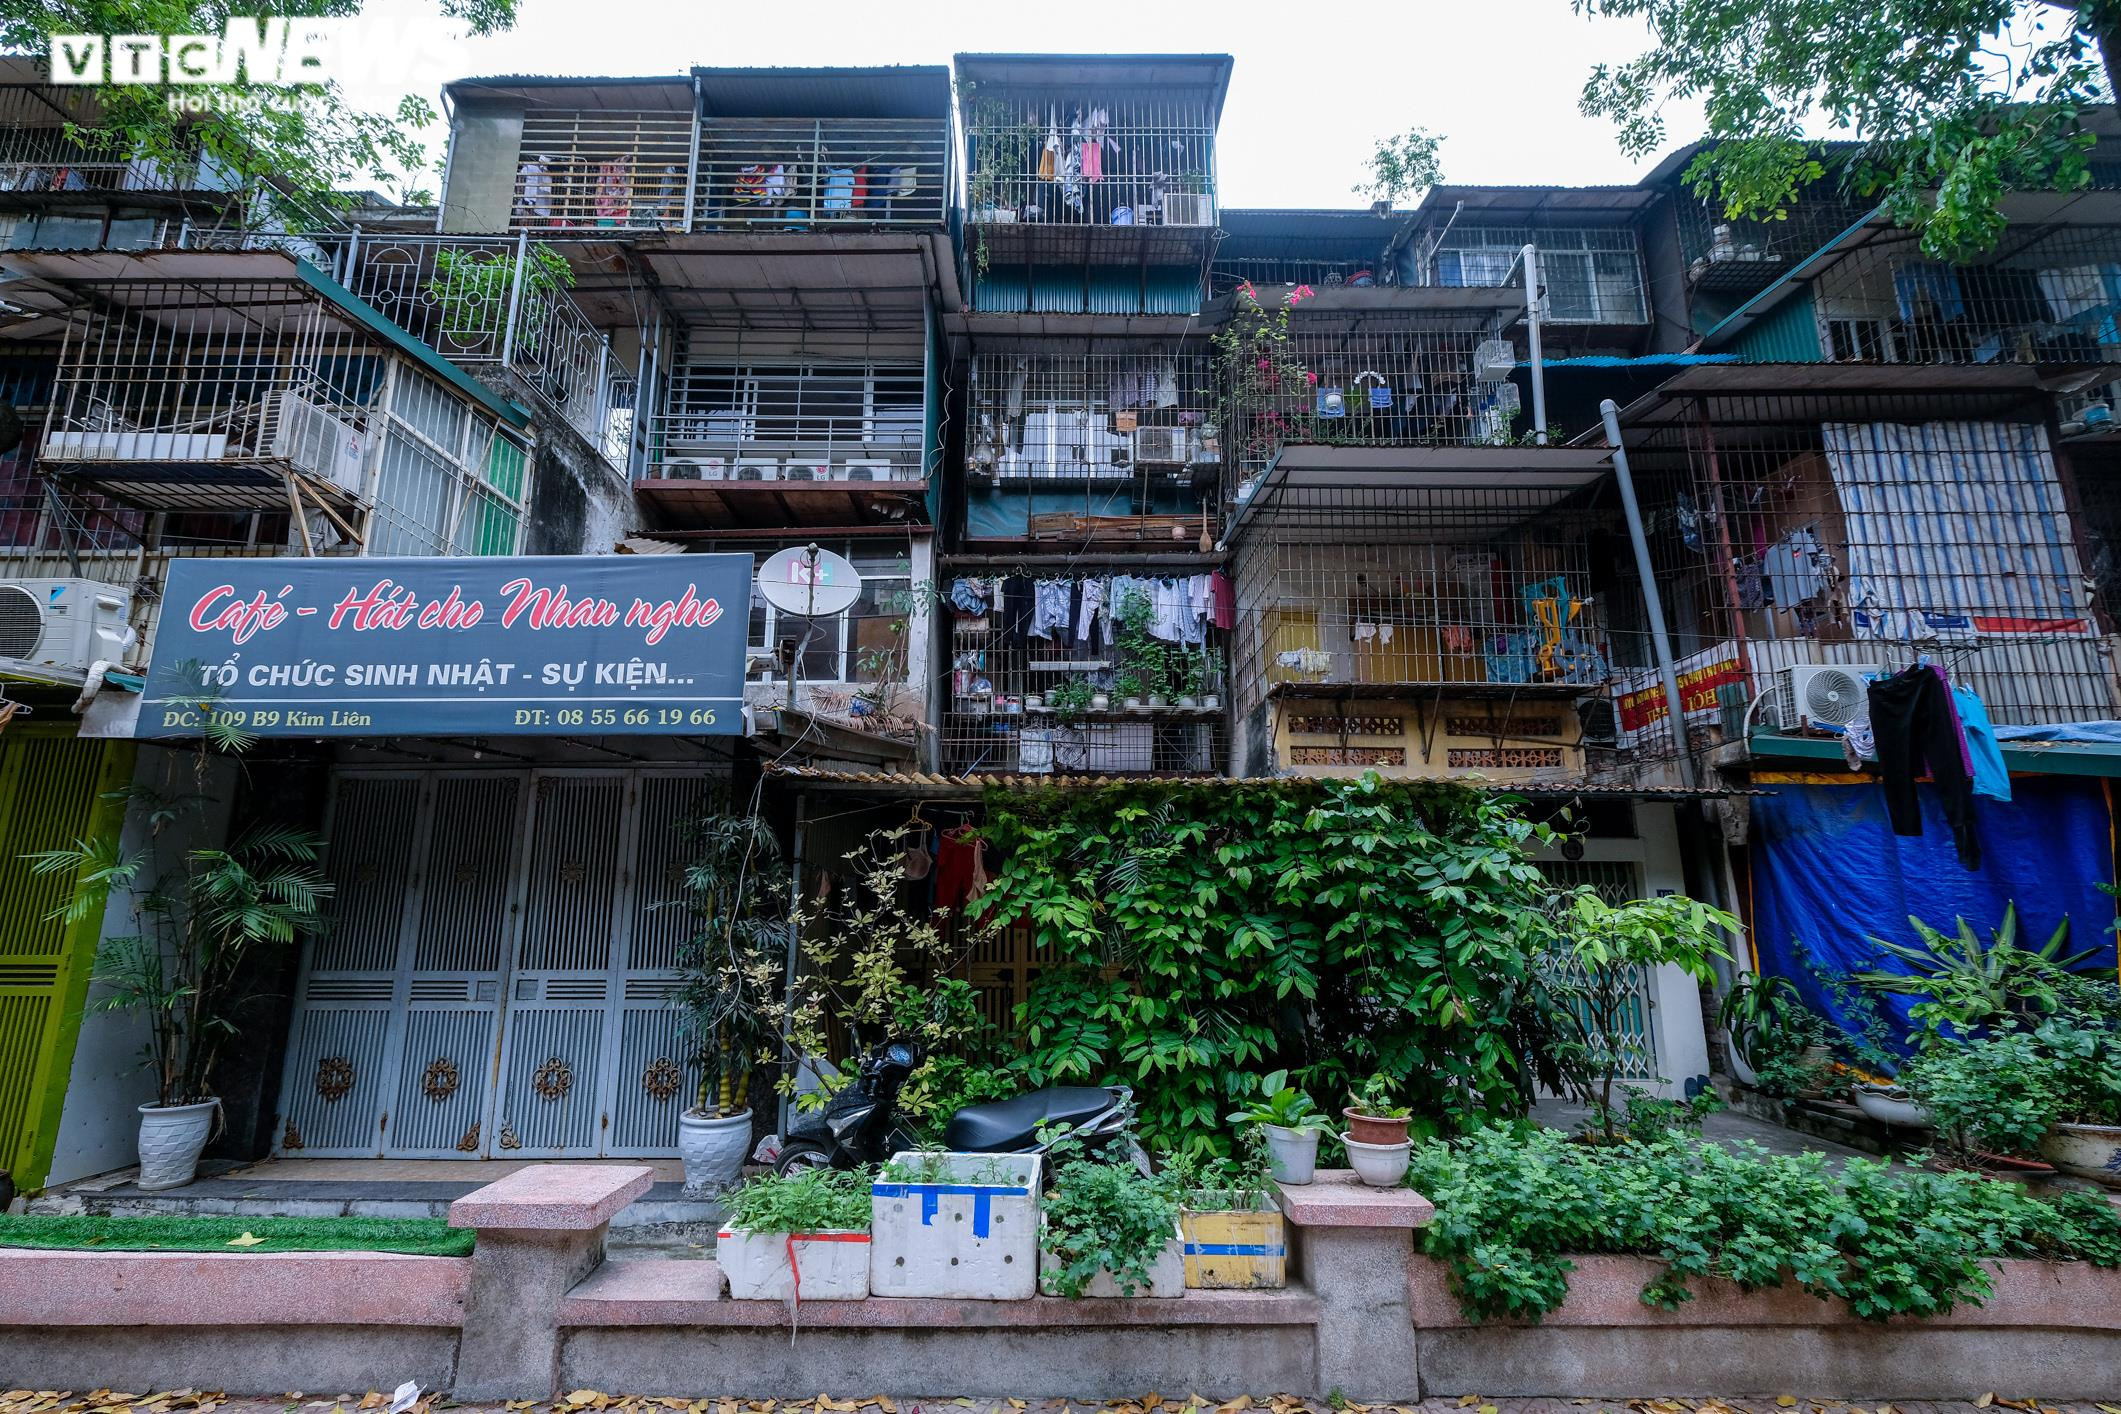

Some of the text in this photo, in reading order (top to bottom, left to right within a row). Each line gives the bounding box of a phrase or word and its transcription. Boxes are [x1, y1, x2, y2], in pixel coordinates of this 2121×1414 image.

[189, 585, 293, 645] Café
[328, 579, 418, 631] Hát
[418, 585, 483, 629] cho
[500, 577, 620, 630] Nhau
[624, 583, 724, 645] nghe
[199, 652, 241, 687] TỔ
[248, 659, 336, 687] CHỨC
[344, 664, 418, 686] SINH
[427, 658, 515, 691] NHẬT
[541, 661, 587, 691] SỰ
[594, 657, 694, 690] KIỆN...
[163, 710, 371, 727] ĐC: 109 B9 Kim Liên
[514, 709, 716, 725] ĐT: 08 55 66 19 66
